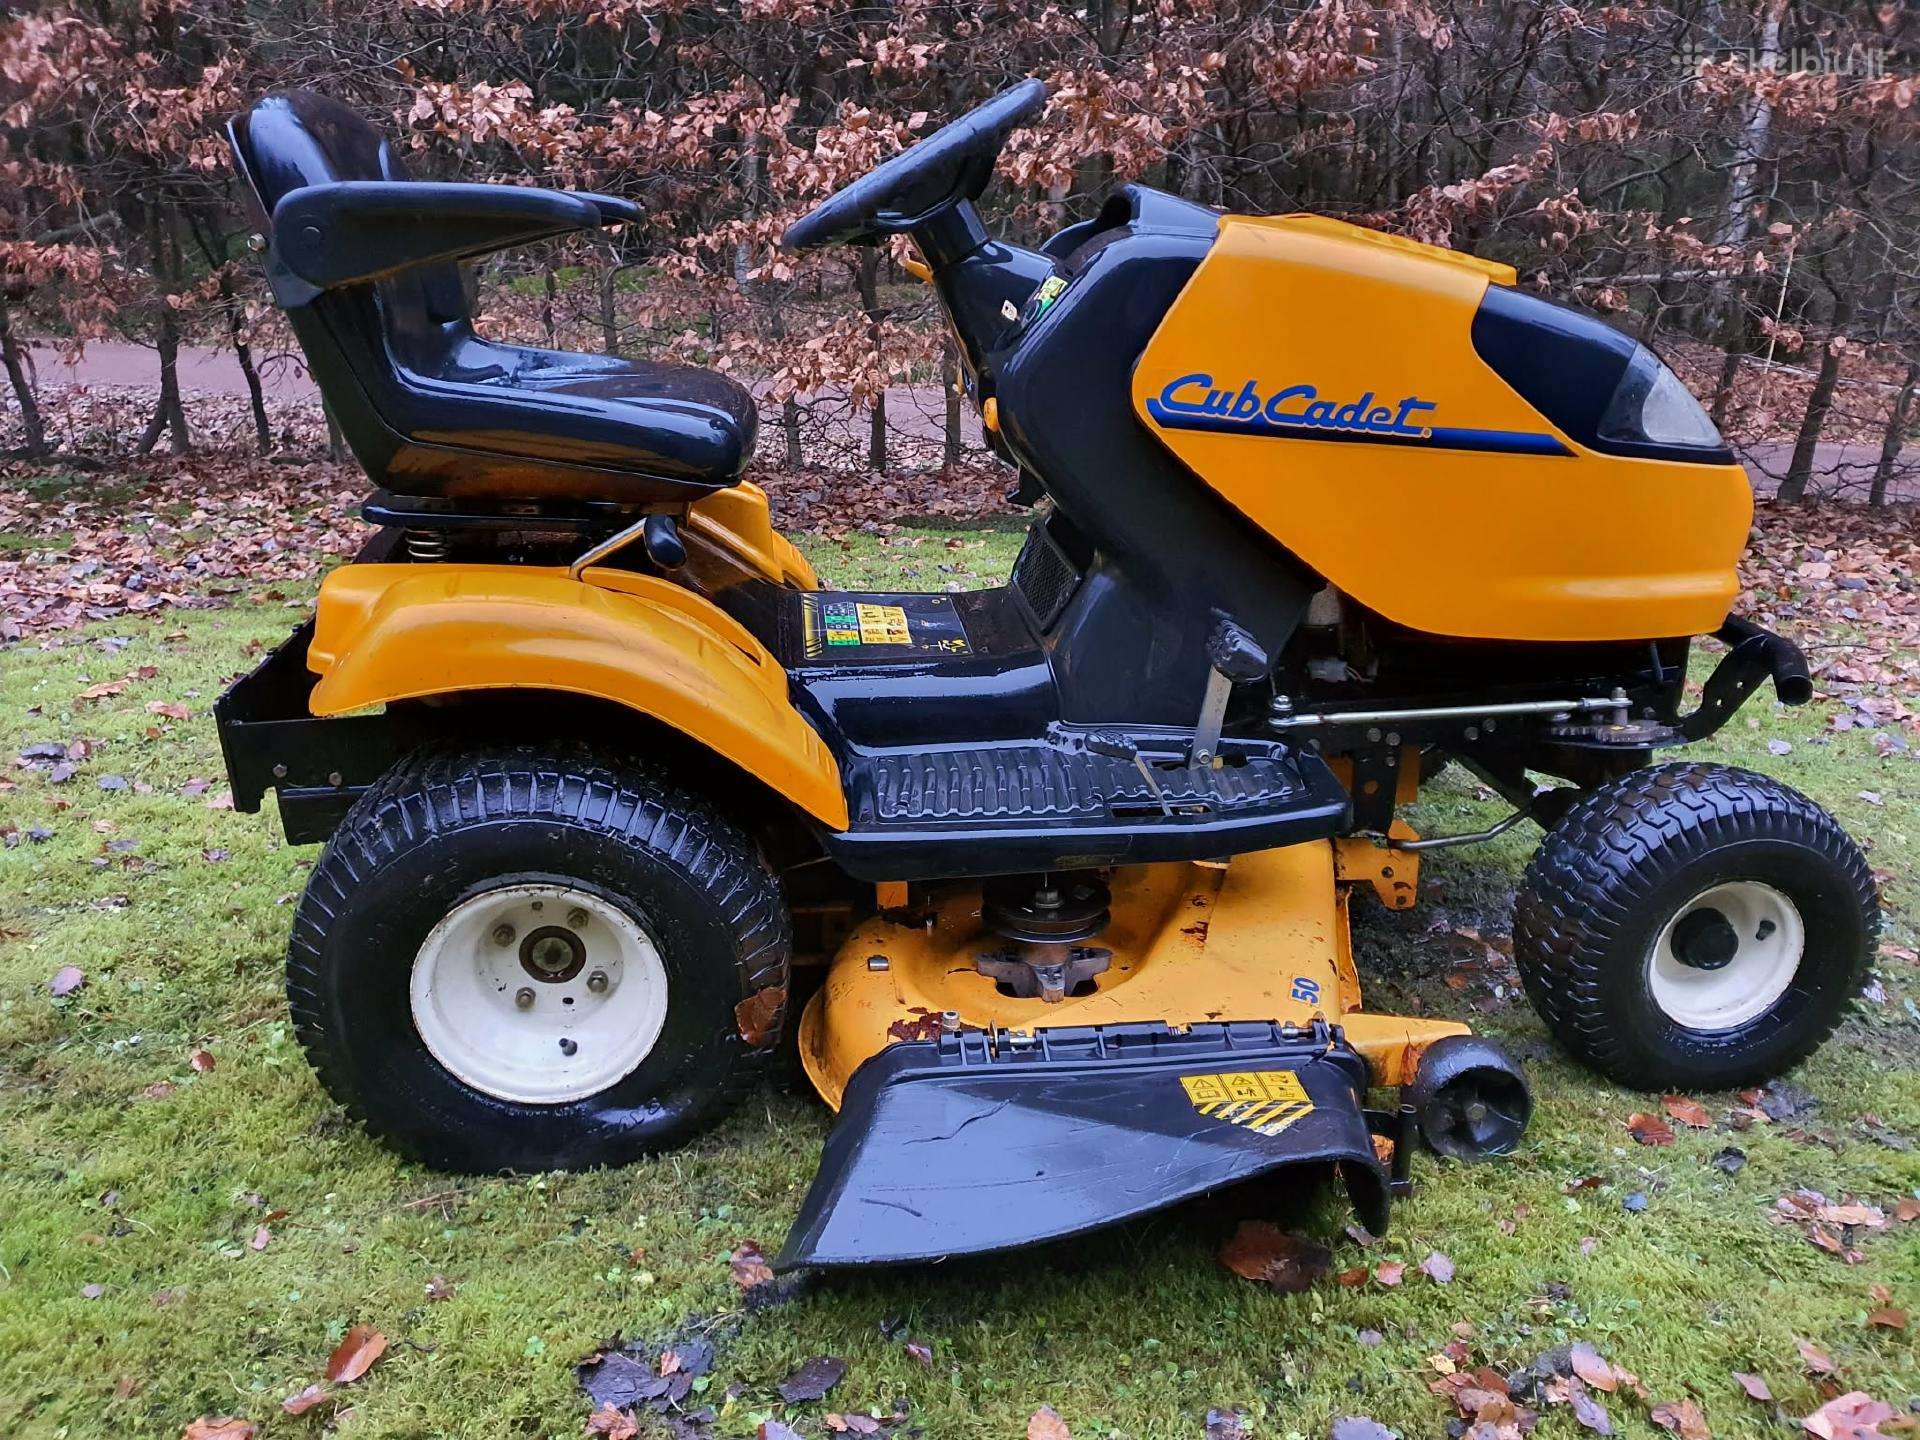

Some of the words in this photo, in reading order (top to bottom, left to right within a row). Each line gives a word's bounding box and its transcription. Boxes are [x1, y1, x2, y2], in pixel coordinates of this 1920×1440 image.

[1158, 372, 1261, 421] Cub
[1264, 384, 1438, 436] Cadet
[1291, 976, 1320, 1004] 50
